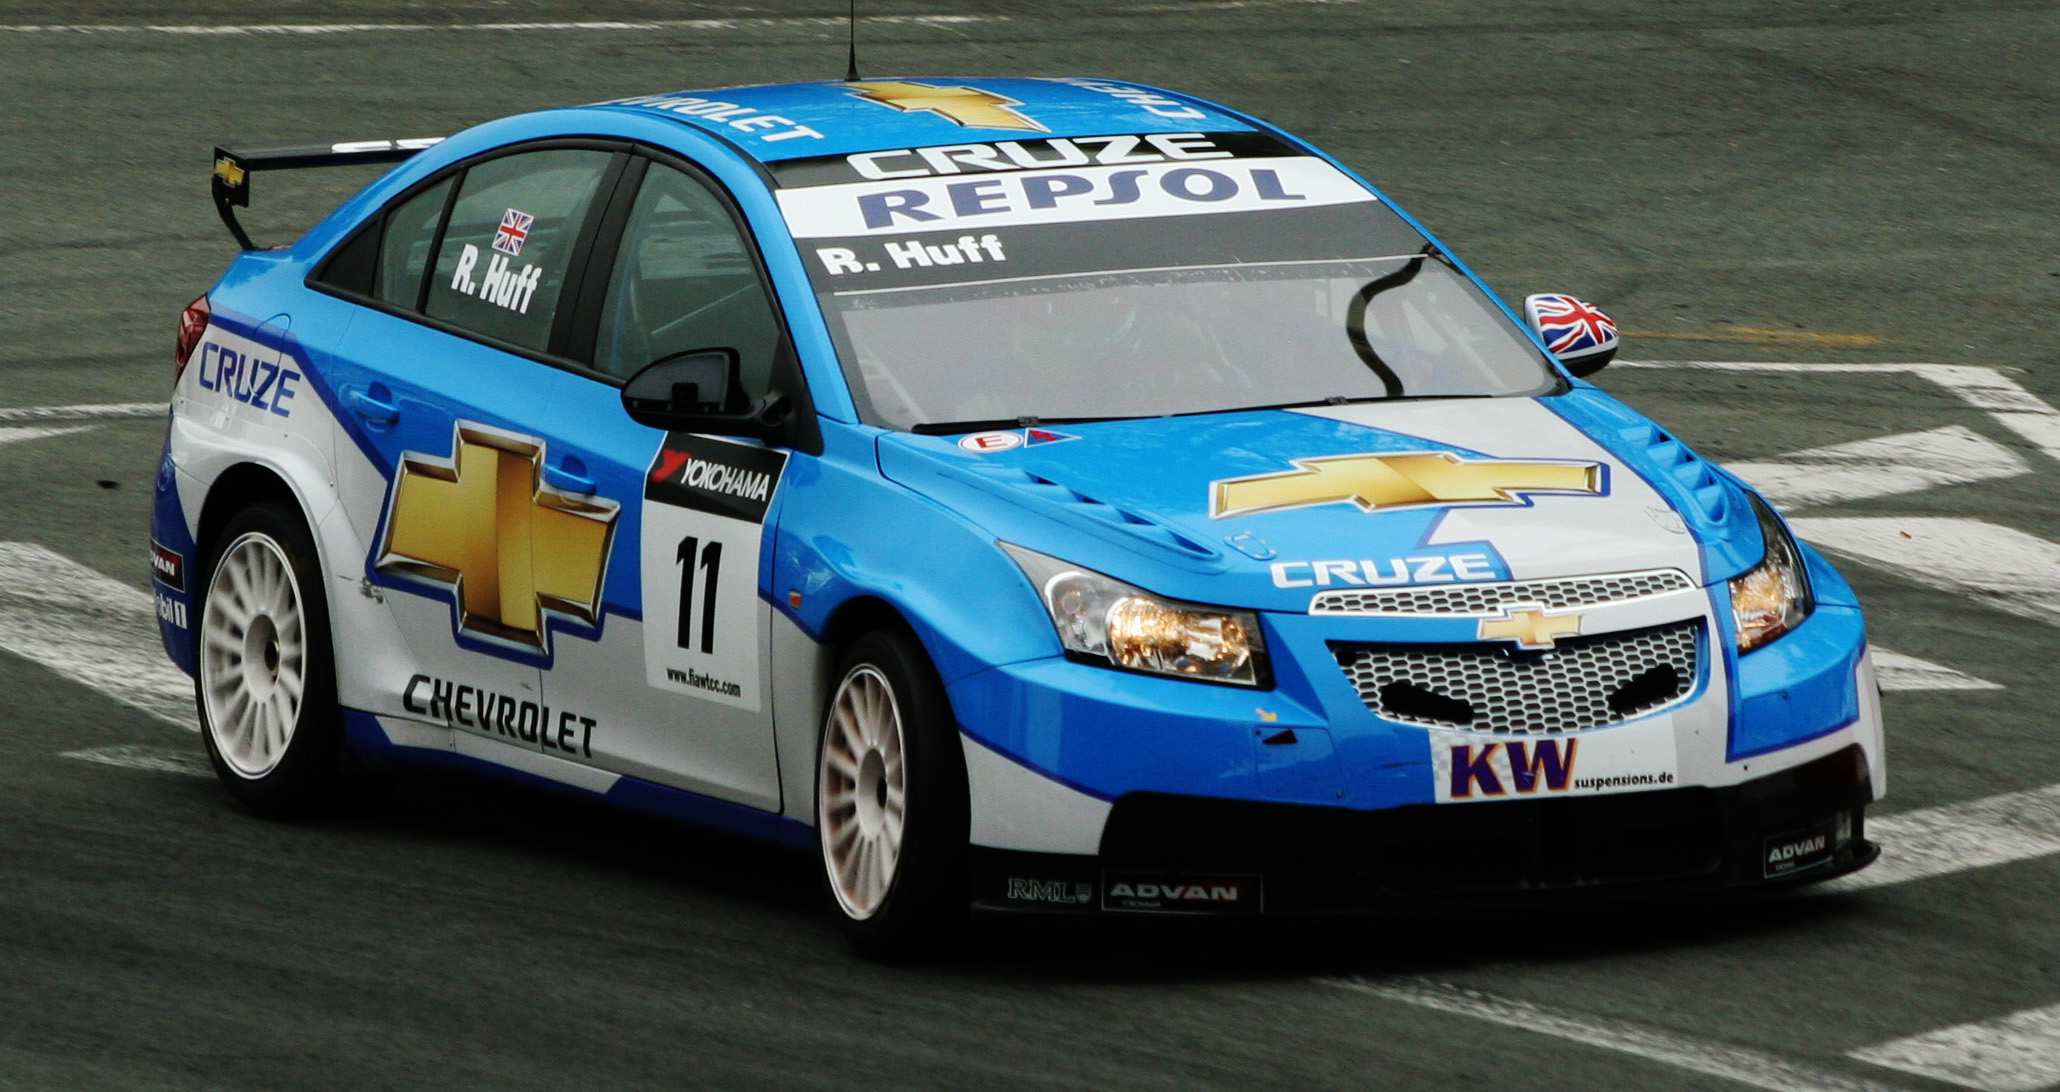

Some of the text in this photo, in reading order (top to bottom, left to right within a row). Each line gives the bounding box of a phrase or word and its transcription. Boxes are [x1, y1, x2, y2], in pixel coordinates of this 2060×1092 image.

[846, 133, 1234, 180] CRUZE
[857, 168, 1306, 230] REPSOL
[816, 234, 1004, 276] R. Huff
[451, 243, 543, 315] R. Huff
[199, 343, 301, 418] CRUZE
[681, 457, 772, 502] YOKOHAMA
[1271, 552, 1497, 589] CRUZE
[676, 535, 723, 655] 11
[665, 666, 742, 699] www.fiawtcc.com
[402, 673, 598, 759] CHEVROLET
[1450, 737, 1675, 799] KW suspensions.de
[1768, 836, 1826, 863] ADVAN
[1007, 877, 1076, 904] RML
[1109, 883, 1239, 901] ADVAN
